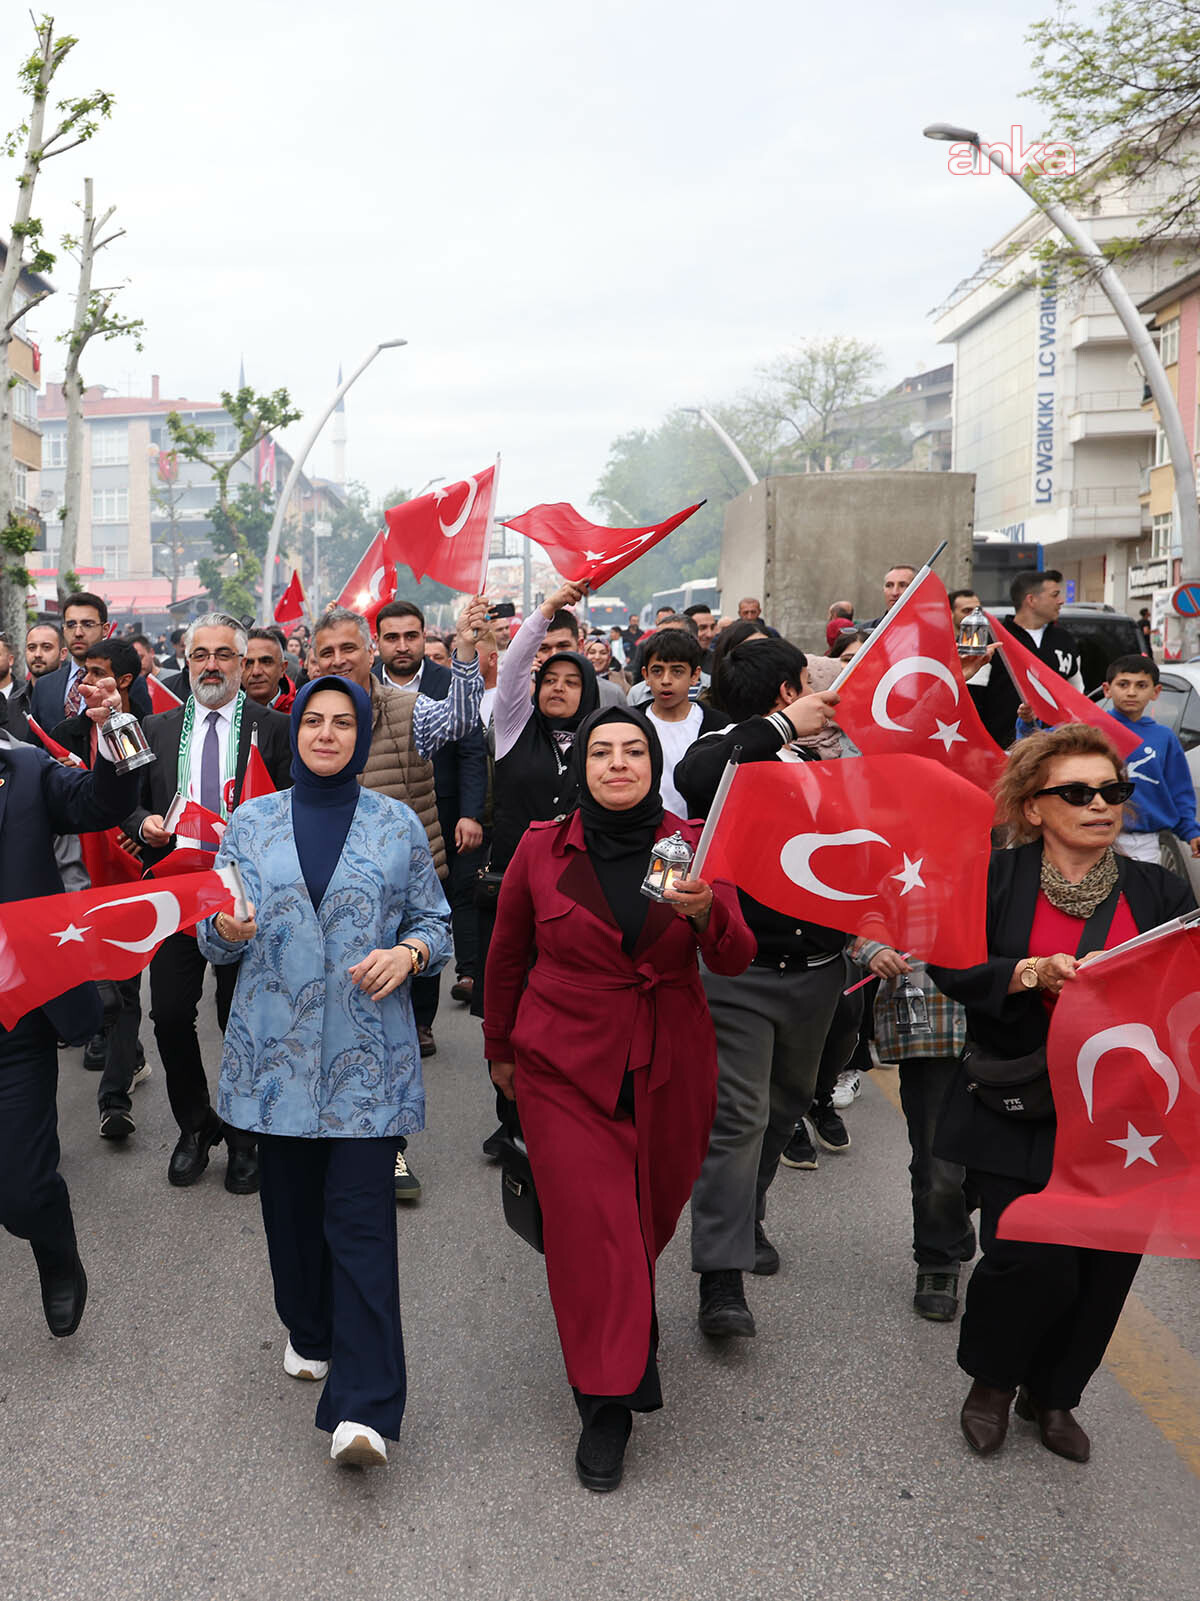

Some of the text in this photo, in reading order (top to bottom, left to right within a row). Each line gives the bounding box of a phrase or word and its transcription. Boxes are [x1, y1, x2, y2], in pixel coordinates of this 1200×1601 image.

[1039, 352, 1056, 377] LC
[1035, 478, 1053, 504] LC
[1055, 649, 1072, 674] W
